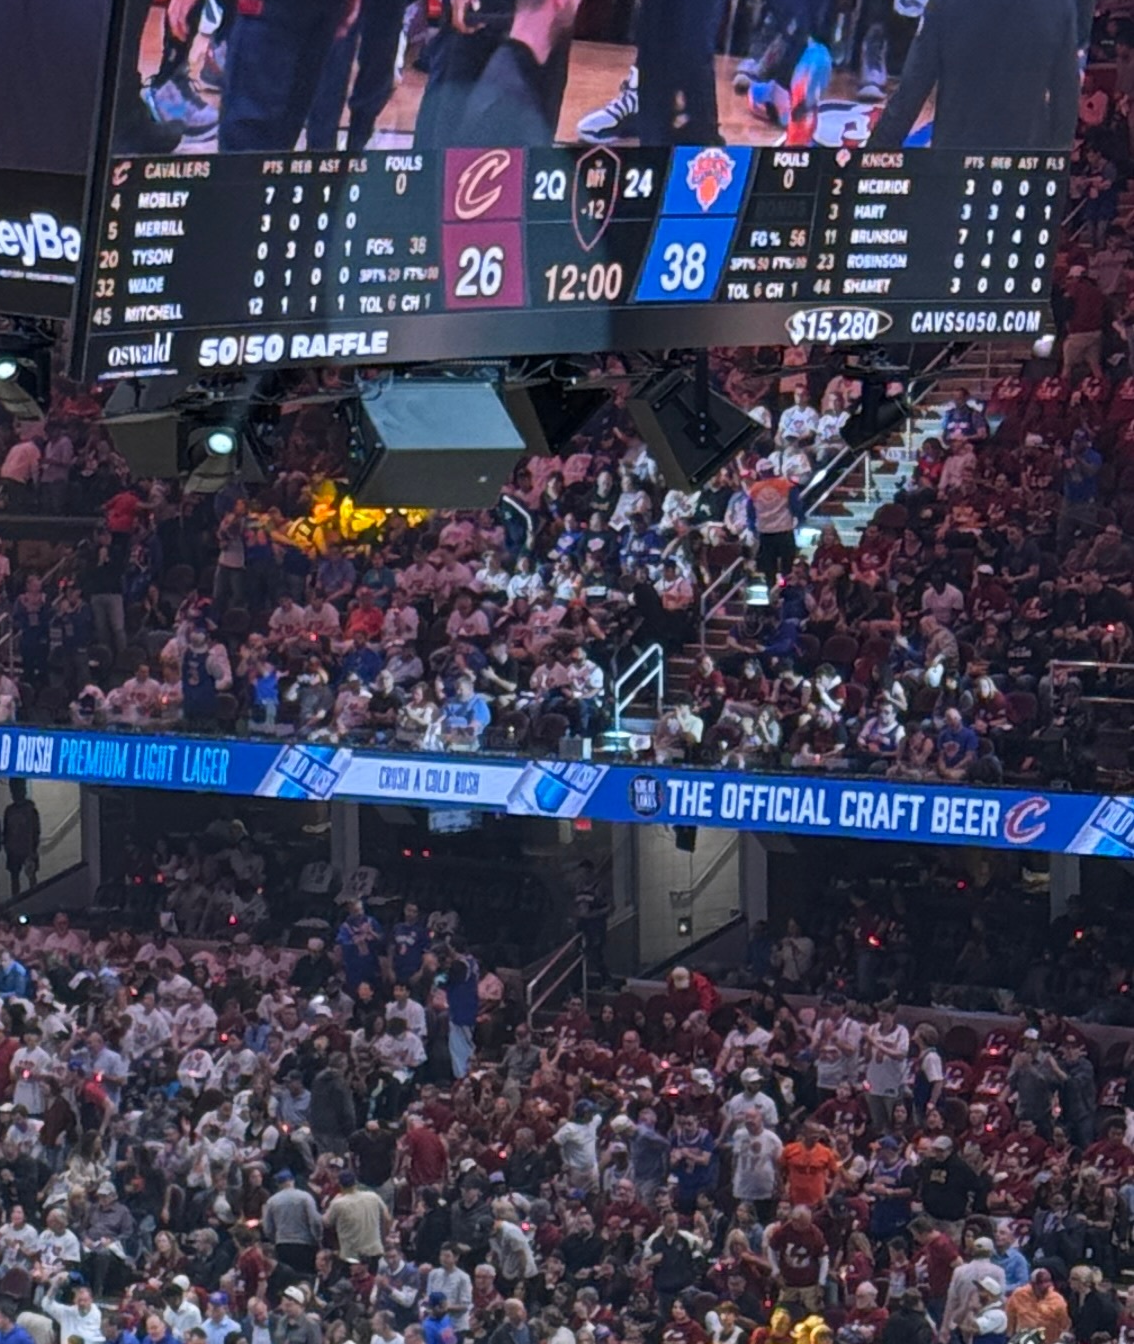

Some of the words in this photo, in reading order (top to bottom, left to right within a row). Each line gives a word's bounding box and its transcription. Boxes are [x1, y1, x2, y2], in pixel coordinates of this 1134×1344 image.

[144, 161, 210, 179] CAVALIERS
[263, 160, 283, 175] PTS
[319, 160, 340, 174] AST
[348, 159, 367, 173] FLS
[385, 156, 422, 172] FOULS
[774, 152, 809, 168] FOULS
[861, 153, 903, 168] KNICKS
[1018, 157, 1038, 170] AST
[396, 173, 406, 195] 0
[533, 171, 566, 201] 2Q
[624, 169, 653, 198] 24
[782, 169, 794, 189] 0
[858, 179, 911, 195] MCBRIDE
[138, 191, 189, 208] MOBLEY
[581, 201, 604, 219] -12
[854, 204, 886, 219] HART
[135, 219, 184, 237] MERRILL
[850, 229, 908, 245] BRUNSON
[789, 230, 806, 247] 56
[99, 250, 119, 268] 20
[132, 248, 174, 266] TYSON
[660, 243, 706, 291] 38
[816, 254, 835, 270] 23
[846, 254, 908, 269] ROBINSON
[454, 245, 504, 297] 26
[95, 279, 115, 297] 32
[128, 276, 164, 294] WADE
[545, 262, 623, 301] 12:00
[727, 284, 751, 300] TOL
[766, 283, 784, 298] CH
[843, 278, 891, 295] SHAMET
[93, 307, 112, 326] 45
[124, 304, 183, 323] MITCHELL
[249, 297, 263, 315] 12
[360, 296, 384, 312] TOL
[401, 295, 420, 311] CH
[789, 311, 879, 346] $15,280
[911, 311, 1041, 334] CAVS5050.COM
[108, 332, 174, 366] oswald
[290, 330, 389, 359] RAFFLE
[15, 734, 54, 774] RUSH
[57, 737, 130, 778] PREMIUM
[132, 743, 178, 781] LIGHT
[182, 745, 231, 786] LAGER
[378, 766, 410, 792] CRUSH
[412, 767, 422, 792] A
[424, 768, 451, 794] COLD
[454, 771, 480, 795] RUSH
[667, 778, 714, 818] THE
[720, 783, 831, 826] OFFICIAL
[839, 789, 926, 832] CRAFT
[930, 795, 1000, 837] BEER
